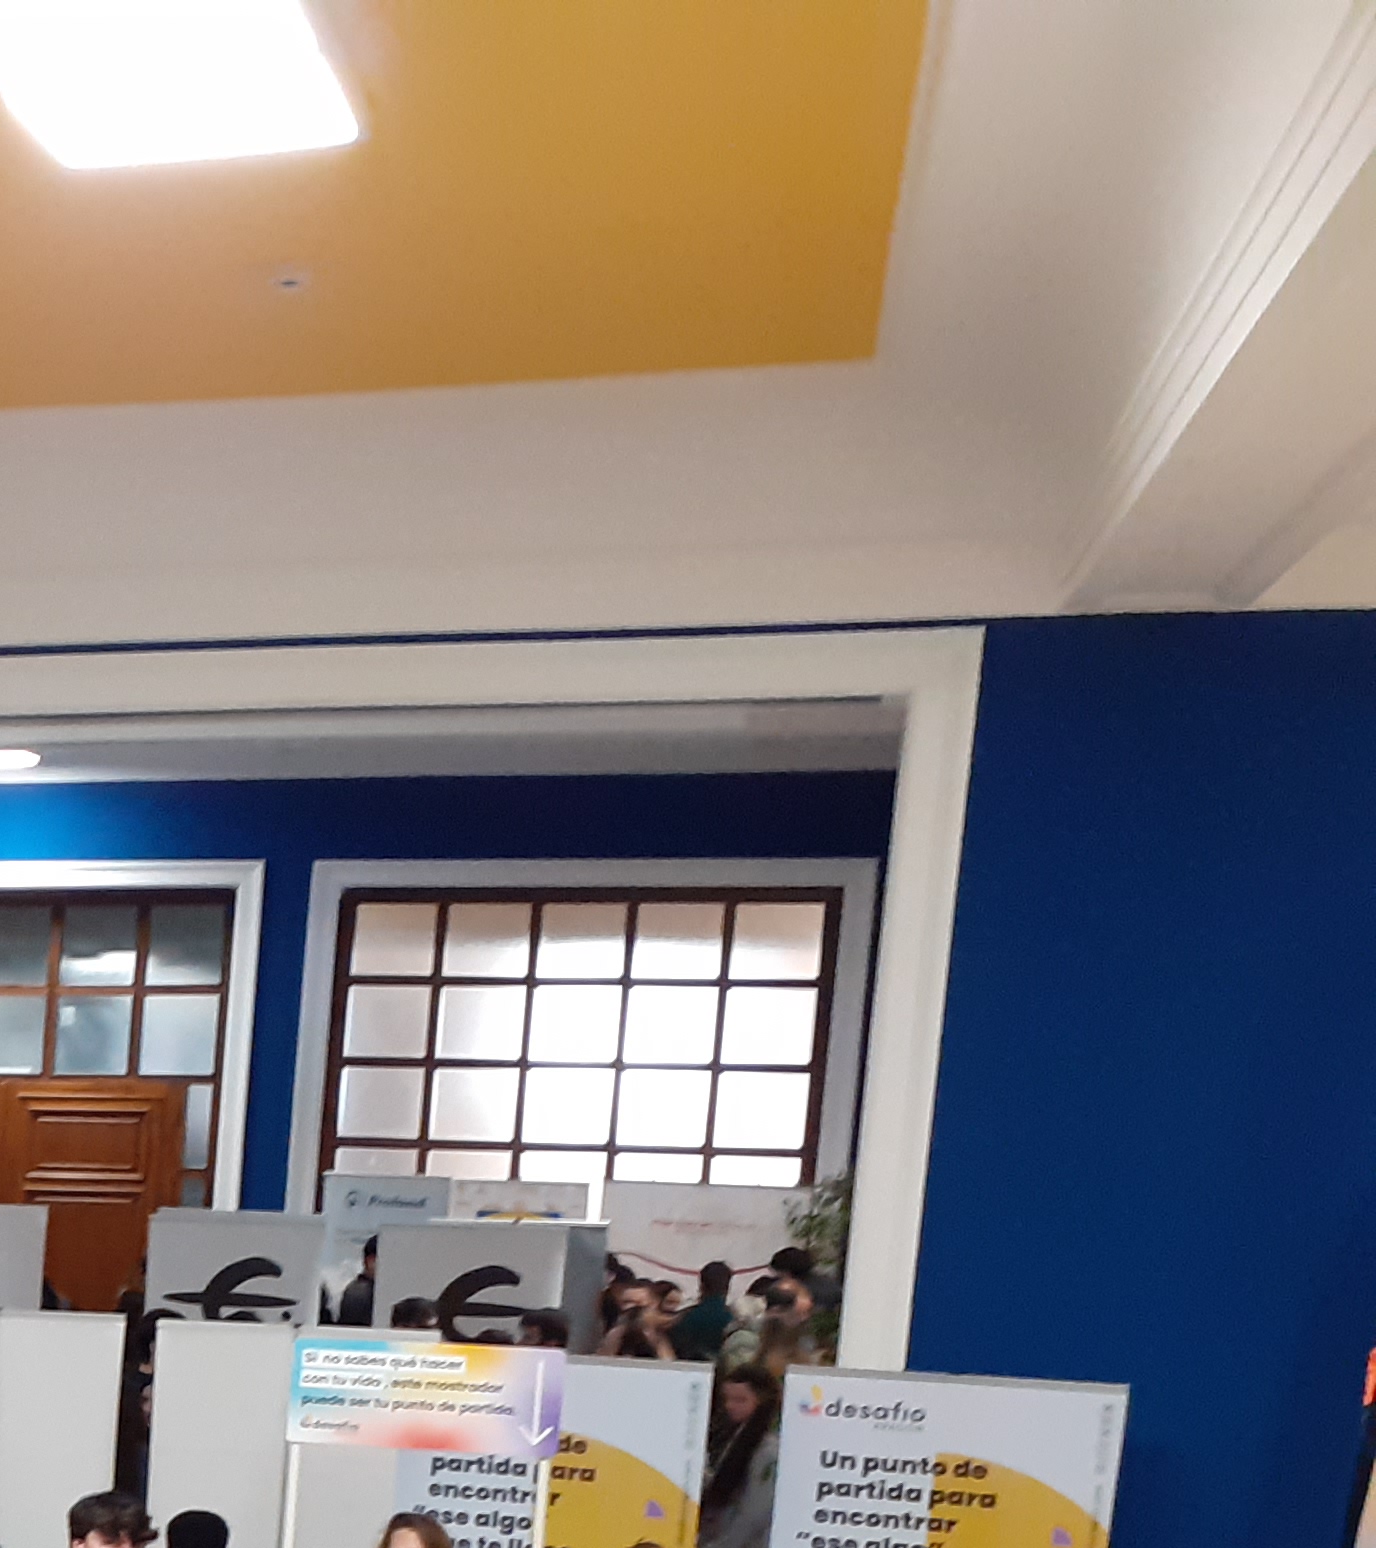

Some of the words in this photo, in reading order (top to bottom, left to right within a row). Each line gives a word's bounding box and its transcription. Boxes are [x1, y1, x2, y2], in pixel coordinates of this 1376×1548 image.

[322, 1354, 342, 1365] no
[302, 1373, 329, 1386] con
[331, 1374, 348, 1387] tu
[424, 1380, 505, 1394] mostrador
[430, 1454, 528, 1477] partida
[819, 1450, 857, 1471] Un
[861, 1455, 948, 1479] punto
[953, 1459, 988, 1480] de
[815, 1479, 923, 1502] partida
[927, 1487, 998, 1511] para
[813, 1506, 959, 1534] encontrar
